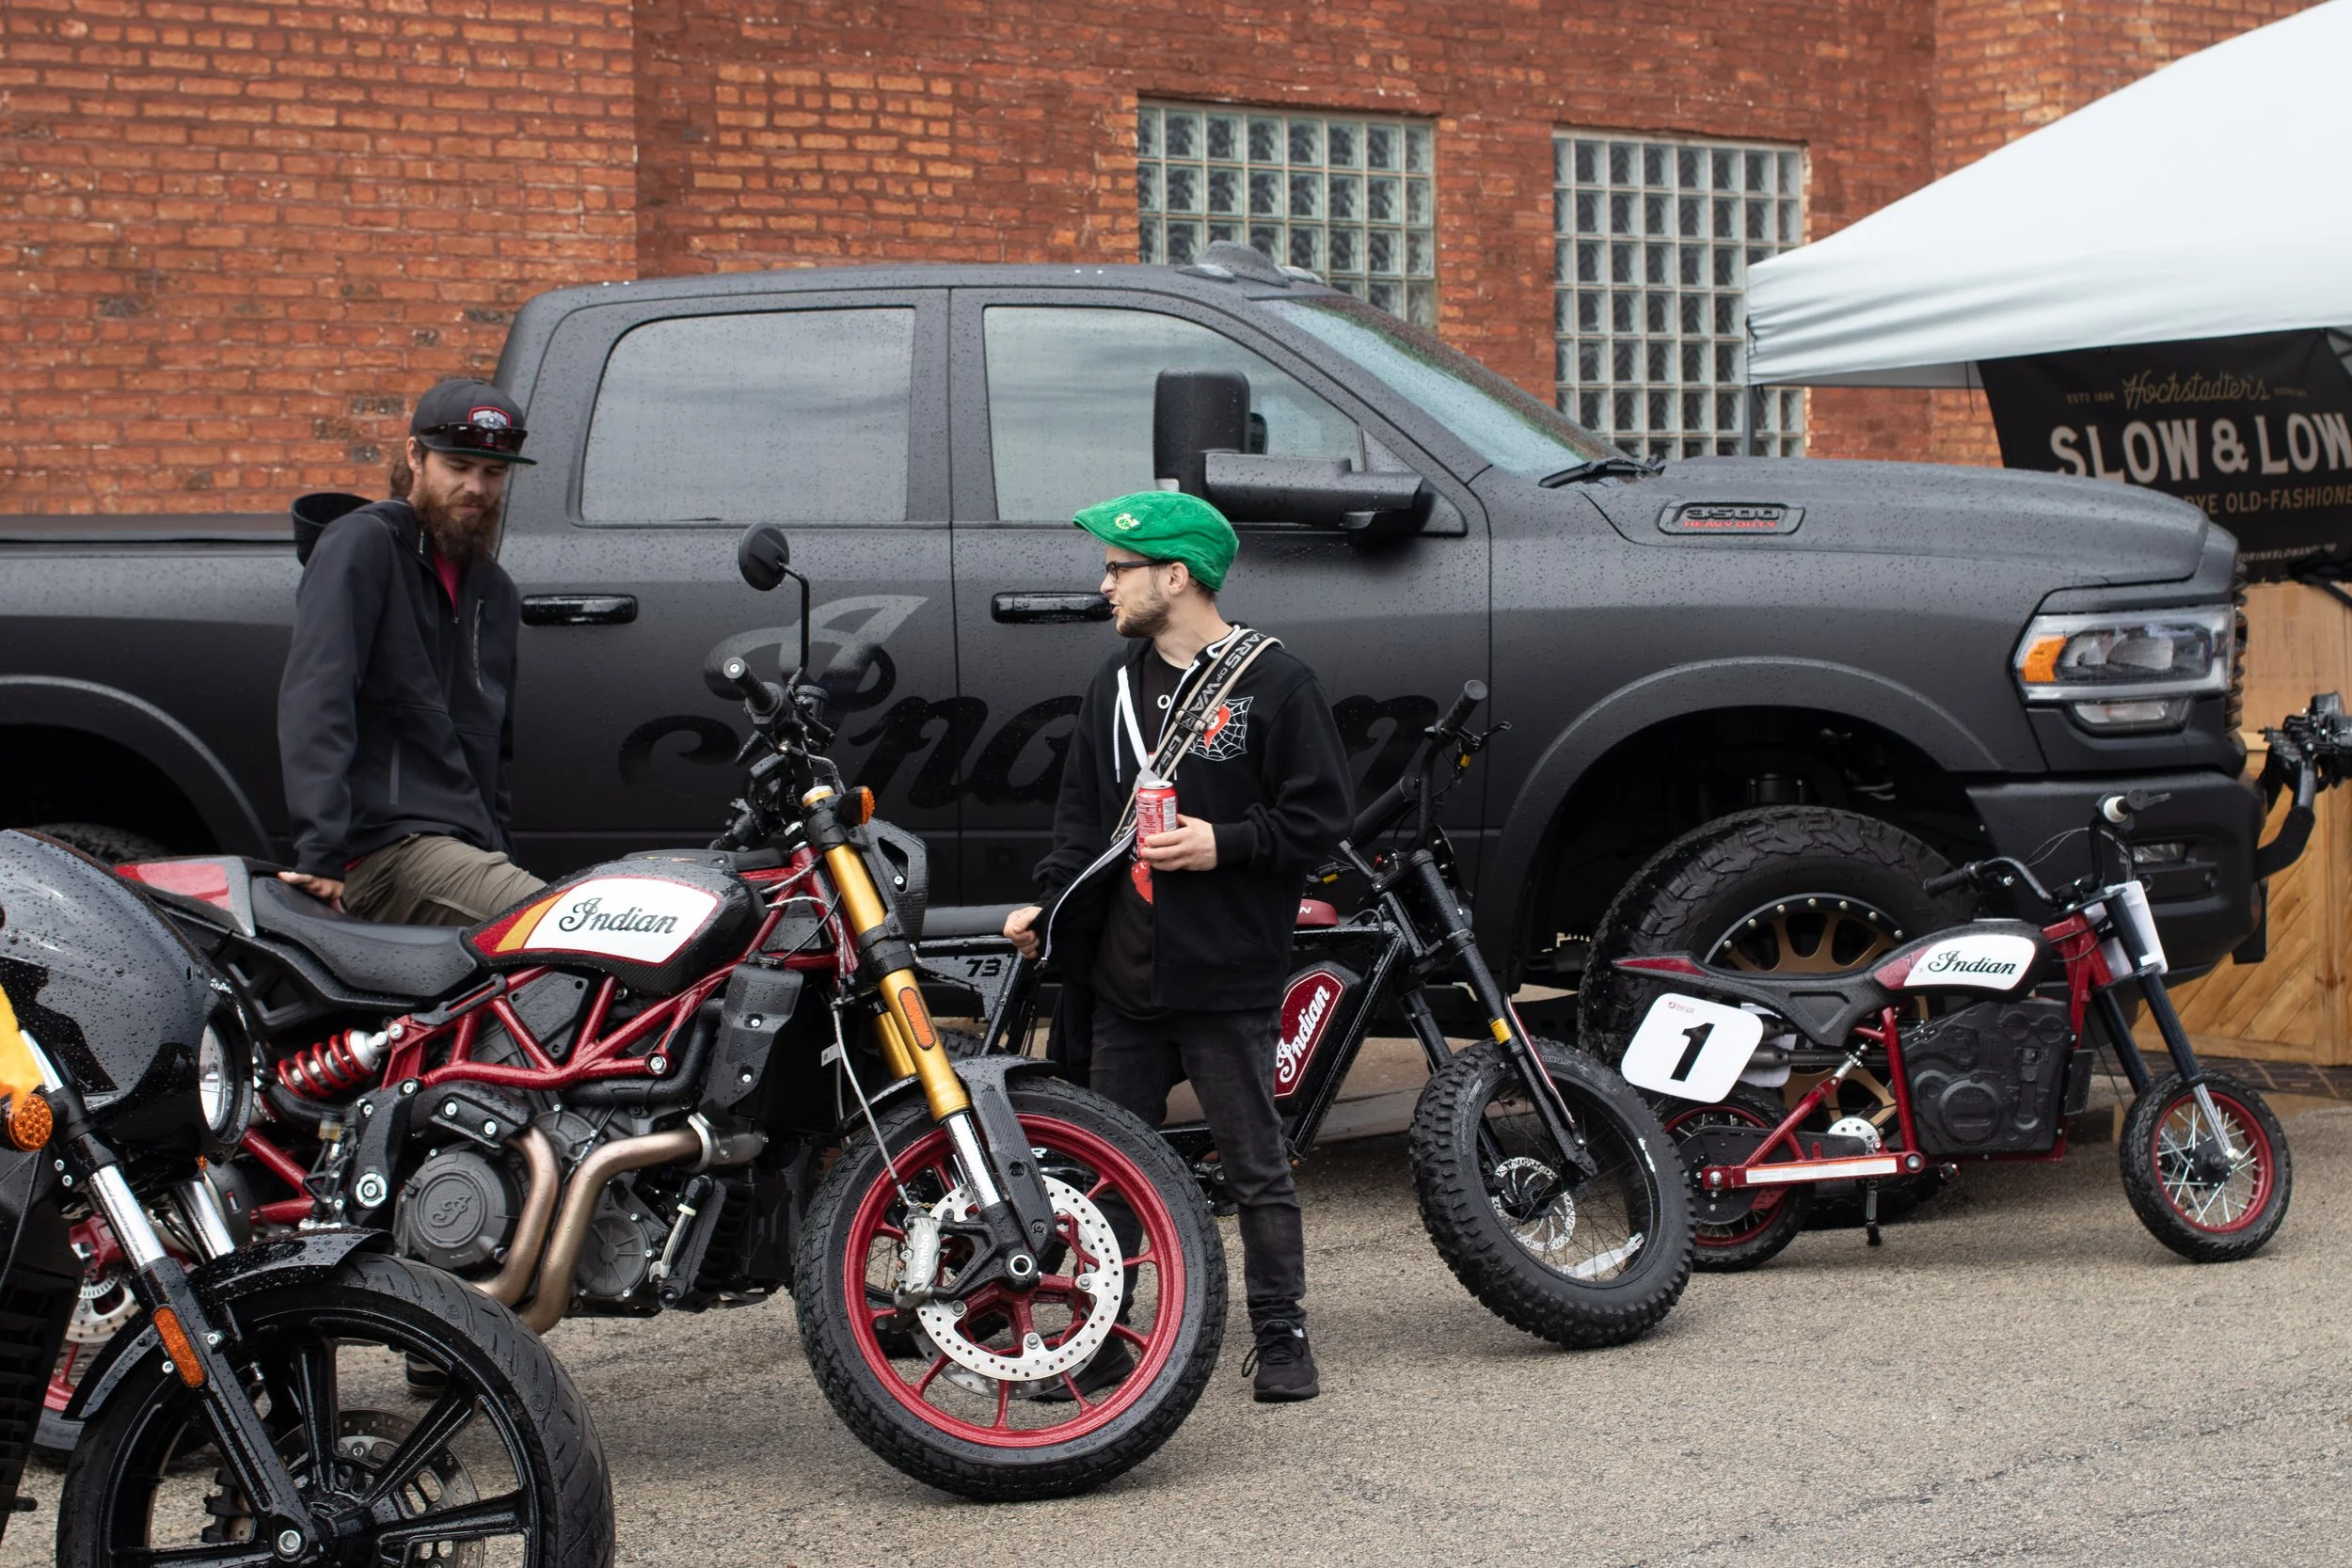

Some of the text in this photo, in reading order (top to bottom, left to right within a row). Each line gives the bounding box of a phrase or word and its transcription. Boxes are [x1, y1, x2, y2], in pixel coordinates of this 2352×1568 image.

[2122, 369, 2270, 410] Hochstadter's
[2050, 412, 2352, 483] SLOW & LOW
[1686, 508, 1780, 520] 3500
[1224, 632, 1267, 669] ARS
[559, 897, 678, 934] Indian
[965, 958, 1002, 977] 73
[1928, 950, 2016, 975] Indian
[1276, 985, 1330, 1083] Indian
[1670, 1022, 1715, 1083] 1
[914, 1234, 930, 1279] brembo
